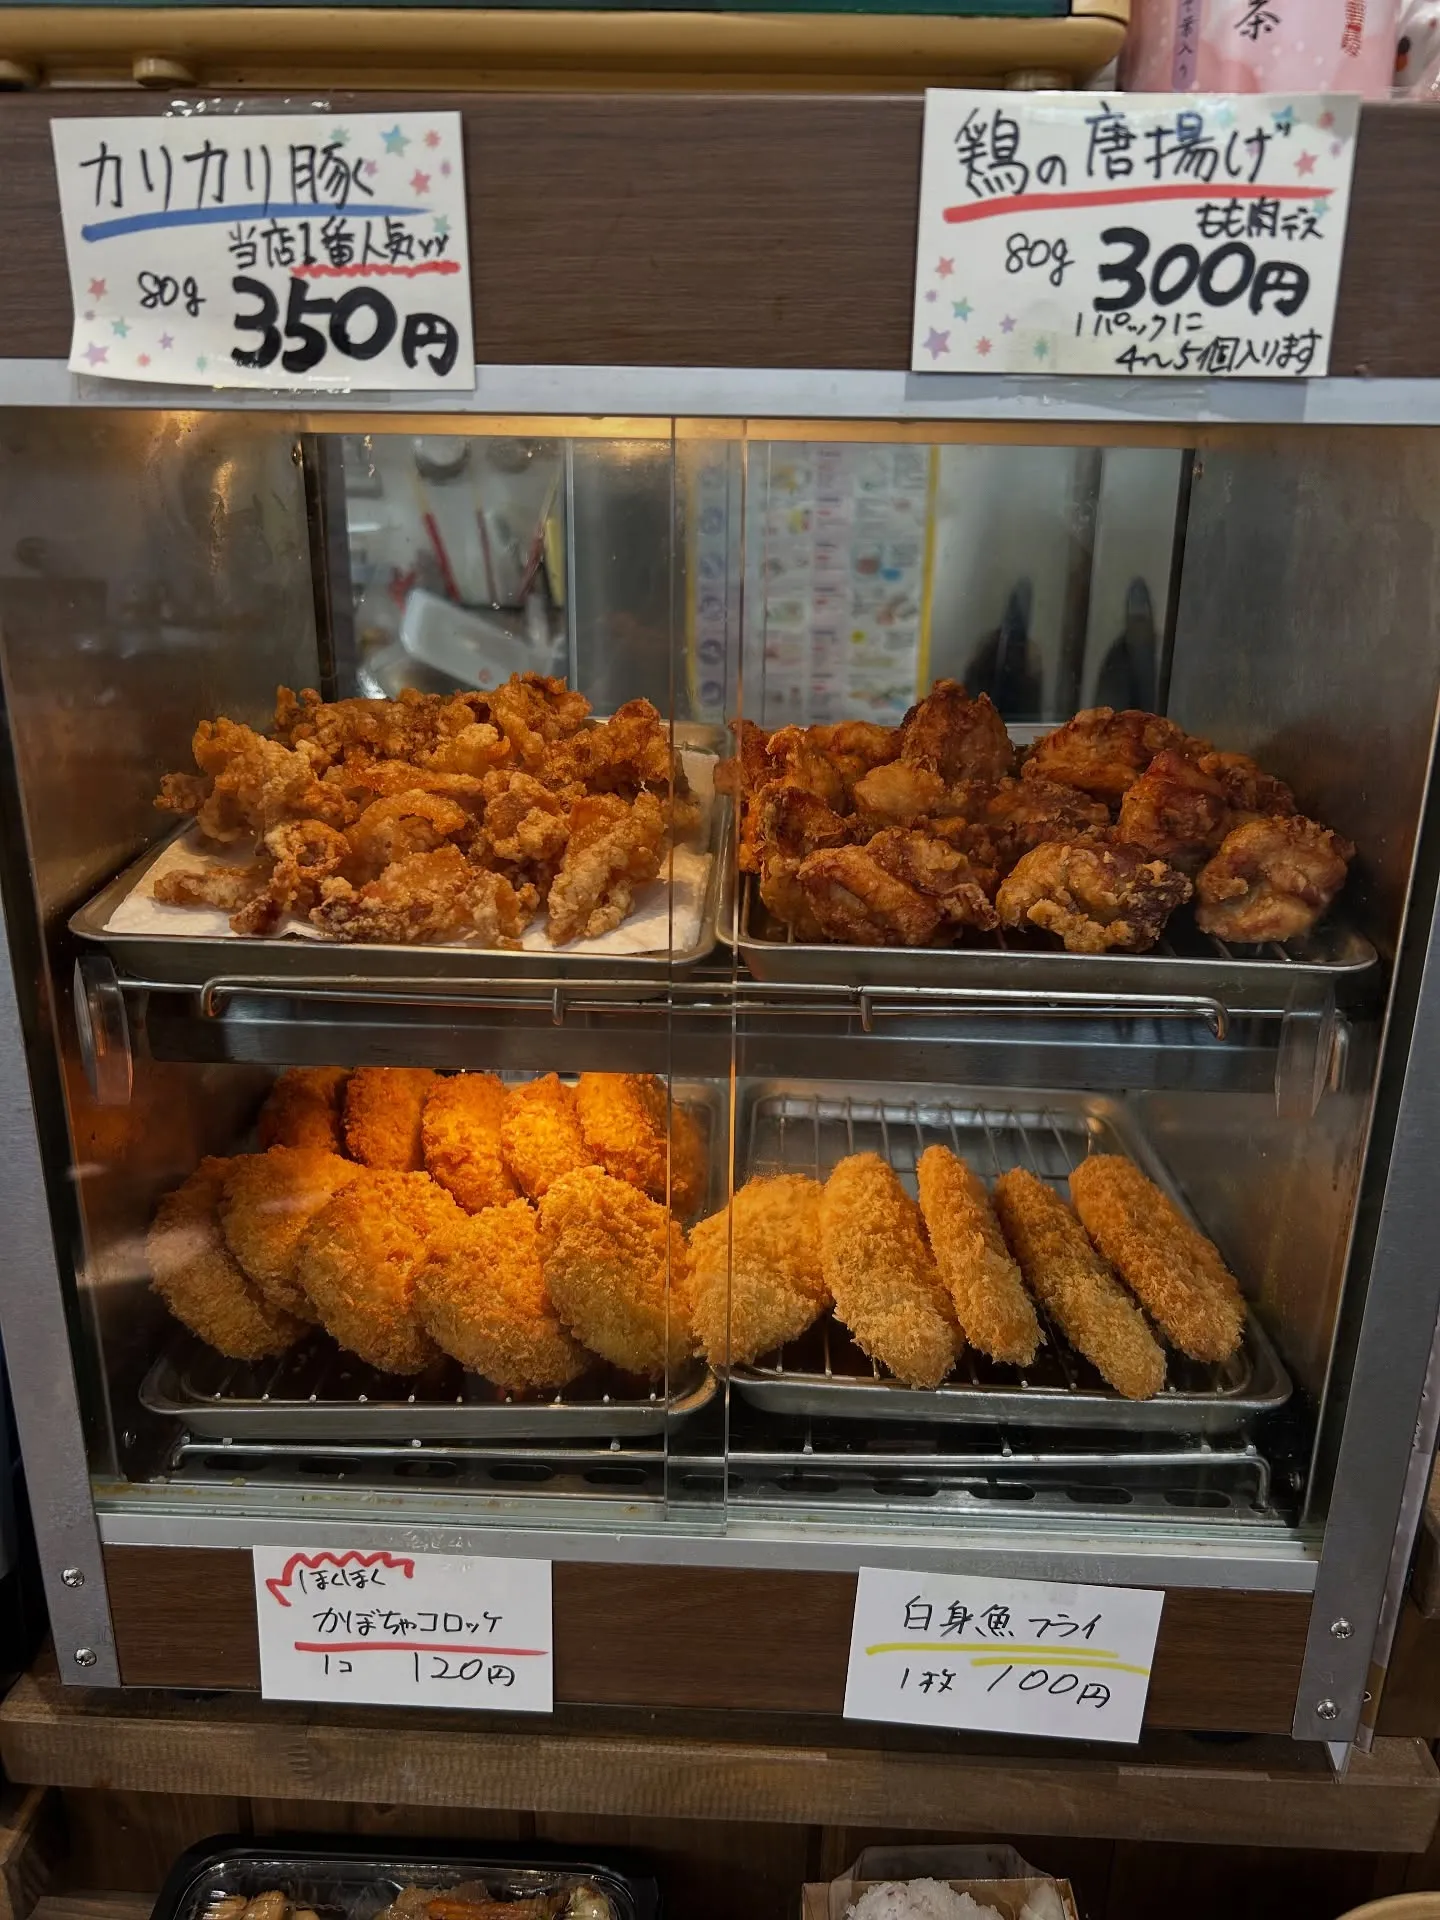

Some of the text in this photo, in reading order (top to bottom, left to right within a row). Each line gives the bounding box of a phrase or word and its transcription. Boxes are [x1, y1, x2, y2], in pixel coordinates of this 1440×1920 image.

[953, 100, 1291, 197] 鶏の唐揚げ
[79, 138, 375, 214] カリカリ豚
[1005, 226, 1311, 317] 80g 300円
[138, 270, 461, 377] 80g 350円
[299, 1568, 386, 1594] ほくほく
[312, 1606, 503, 1636] かぼちゃコロッケ
[903, 1594, 1103, 1640] 白身魚フライ
[413, 1652, 516, 1687] 120円
[900, 1664, 1111, 1709] 1枚 100円
